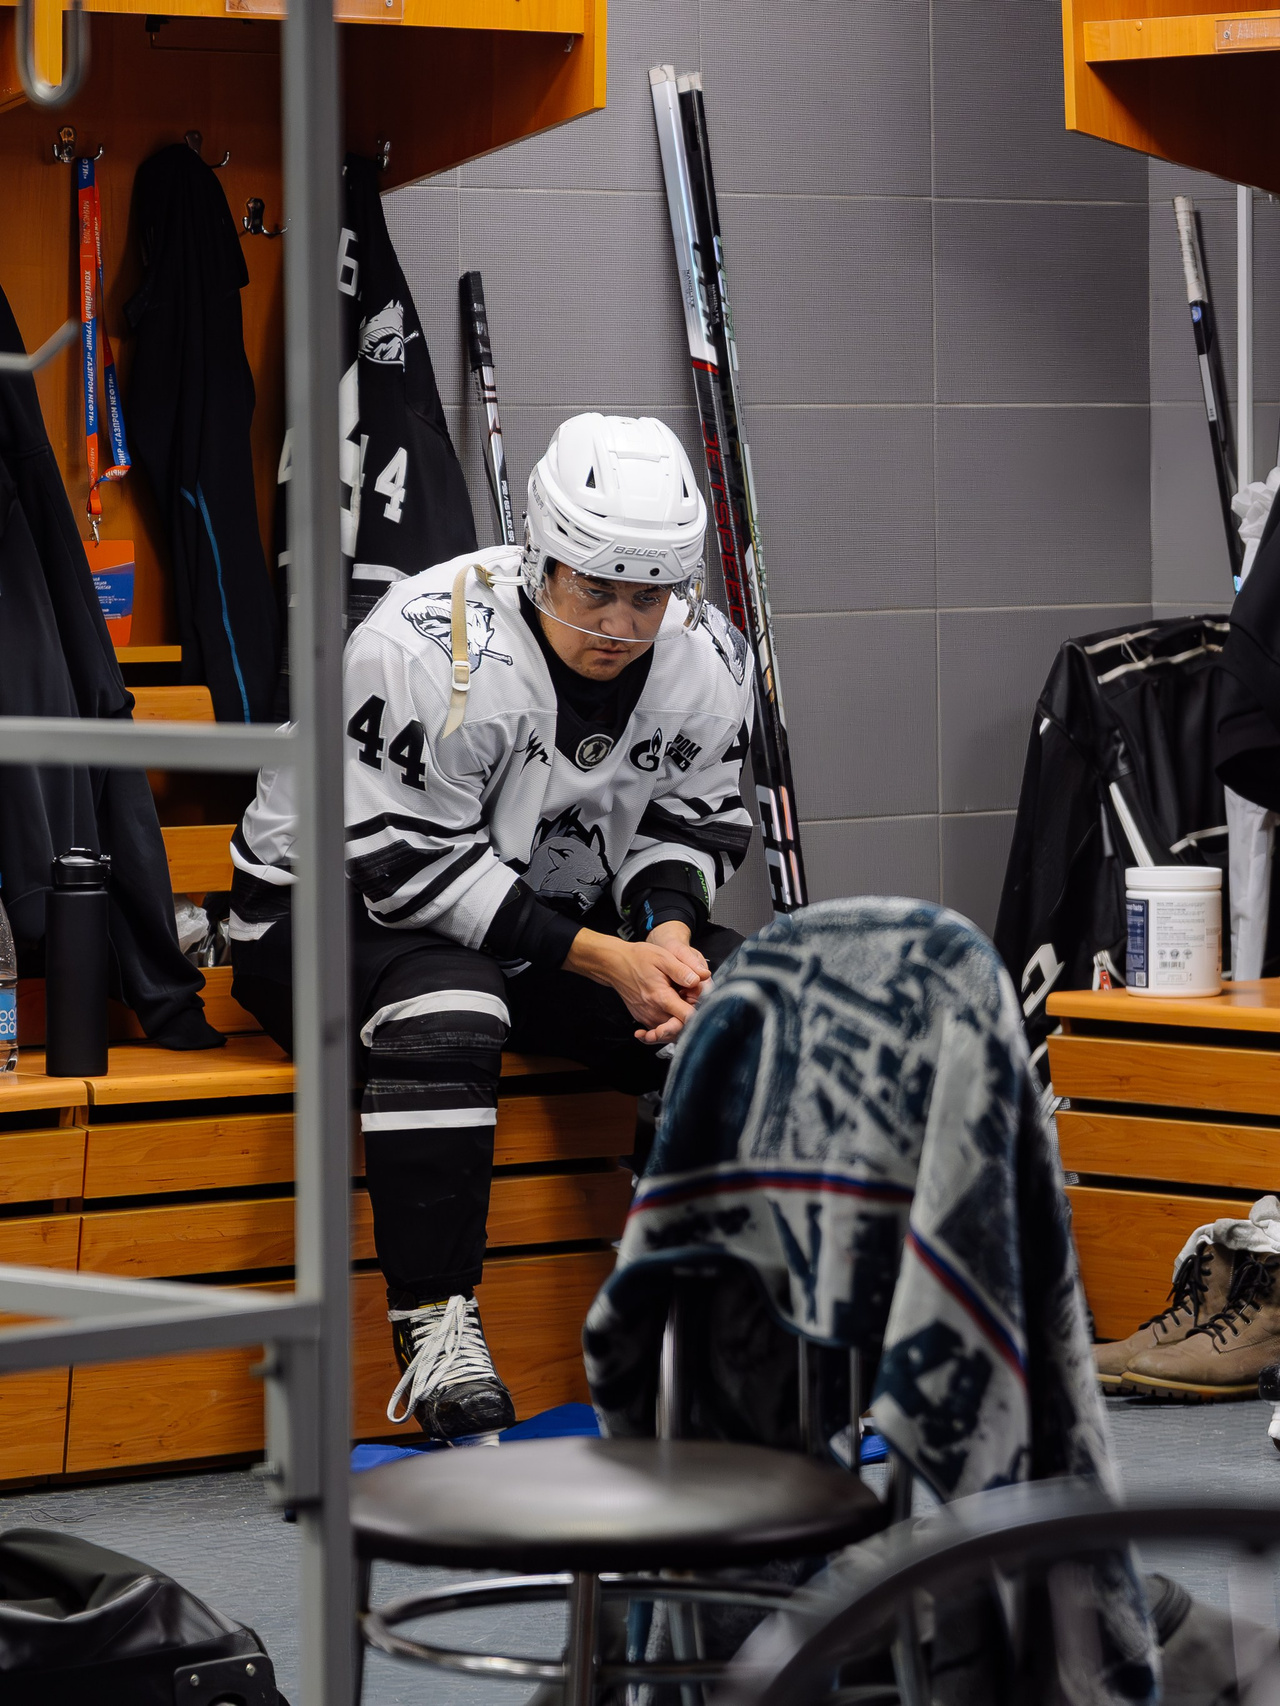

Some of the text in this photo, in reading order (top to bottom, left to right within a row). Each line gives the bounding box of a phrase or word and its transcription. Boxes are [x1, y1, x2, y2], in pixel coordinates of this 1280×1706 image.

[702, 420, 747, 635] JETSPEED
[346, 693, 428, 792] 44
[755, 784, 793, 906] CC
